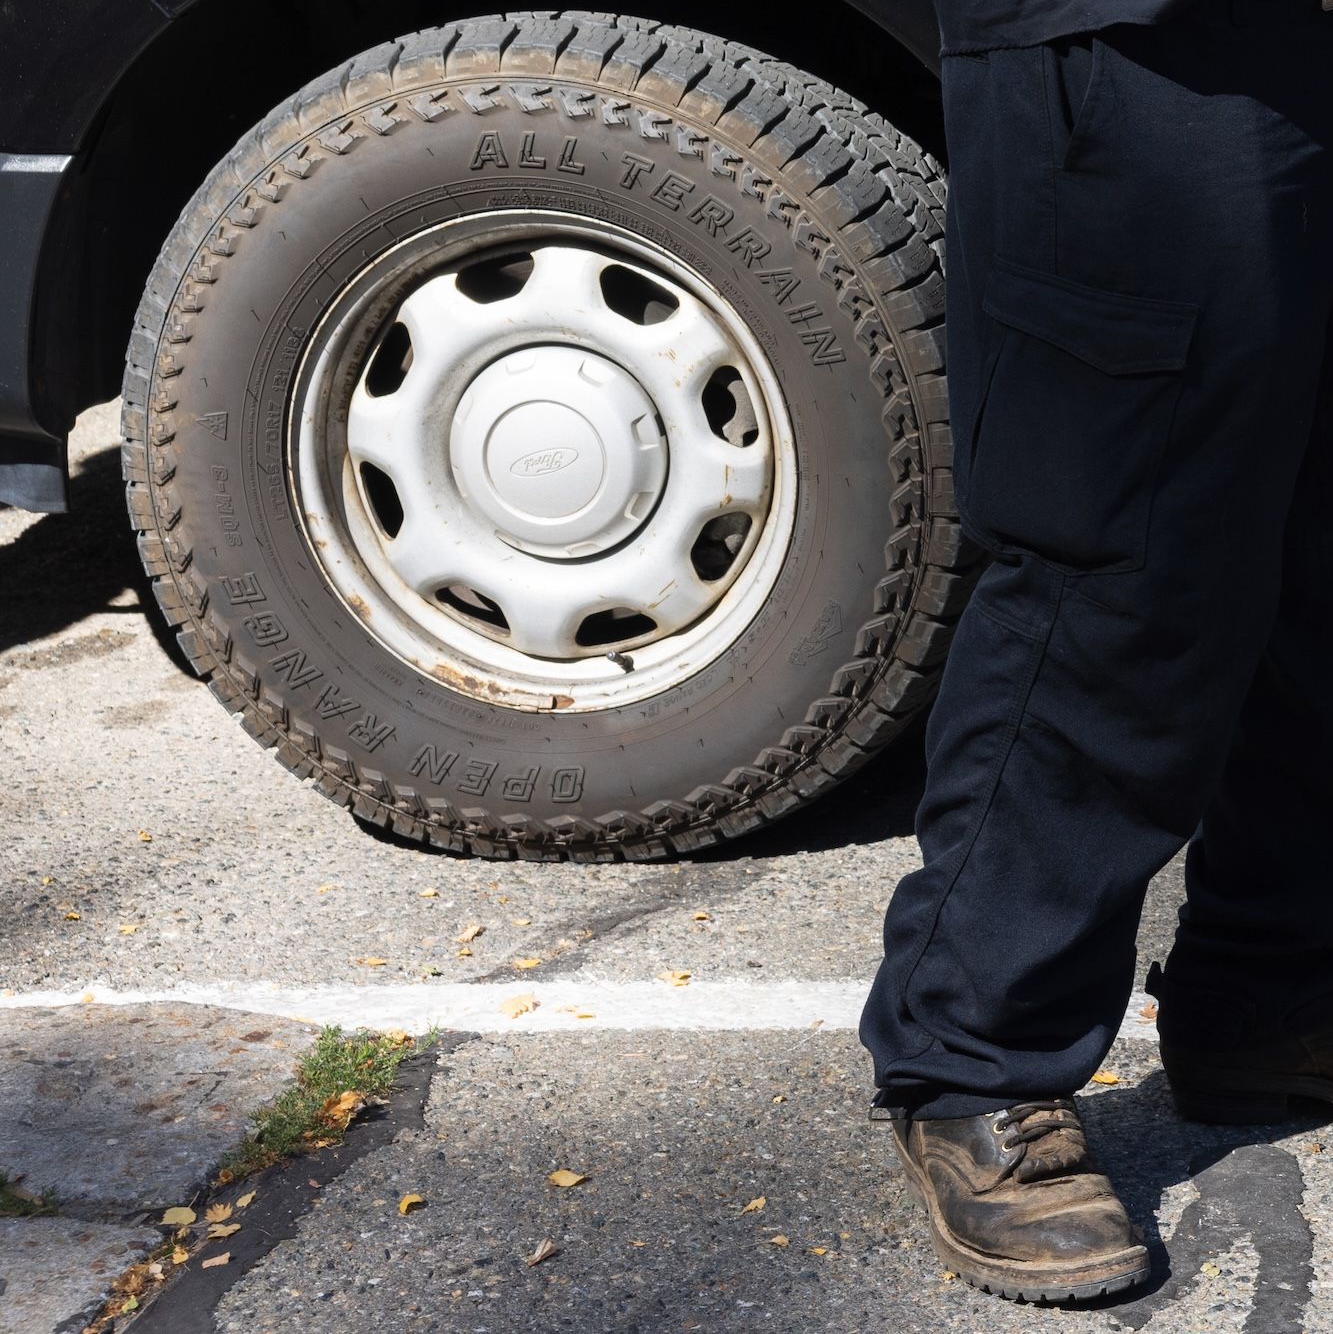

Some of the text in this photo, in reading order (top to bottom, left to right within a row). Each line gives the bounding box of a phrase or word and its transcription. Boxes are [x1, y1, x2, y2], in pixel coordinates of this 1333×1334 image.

[469, 129, 587, 175] ALL
[619, 152, 846, 371] TERRAIN
[218, 570, 586, 806] OPEN RANGE
